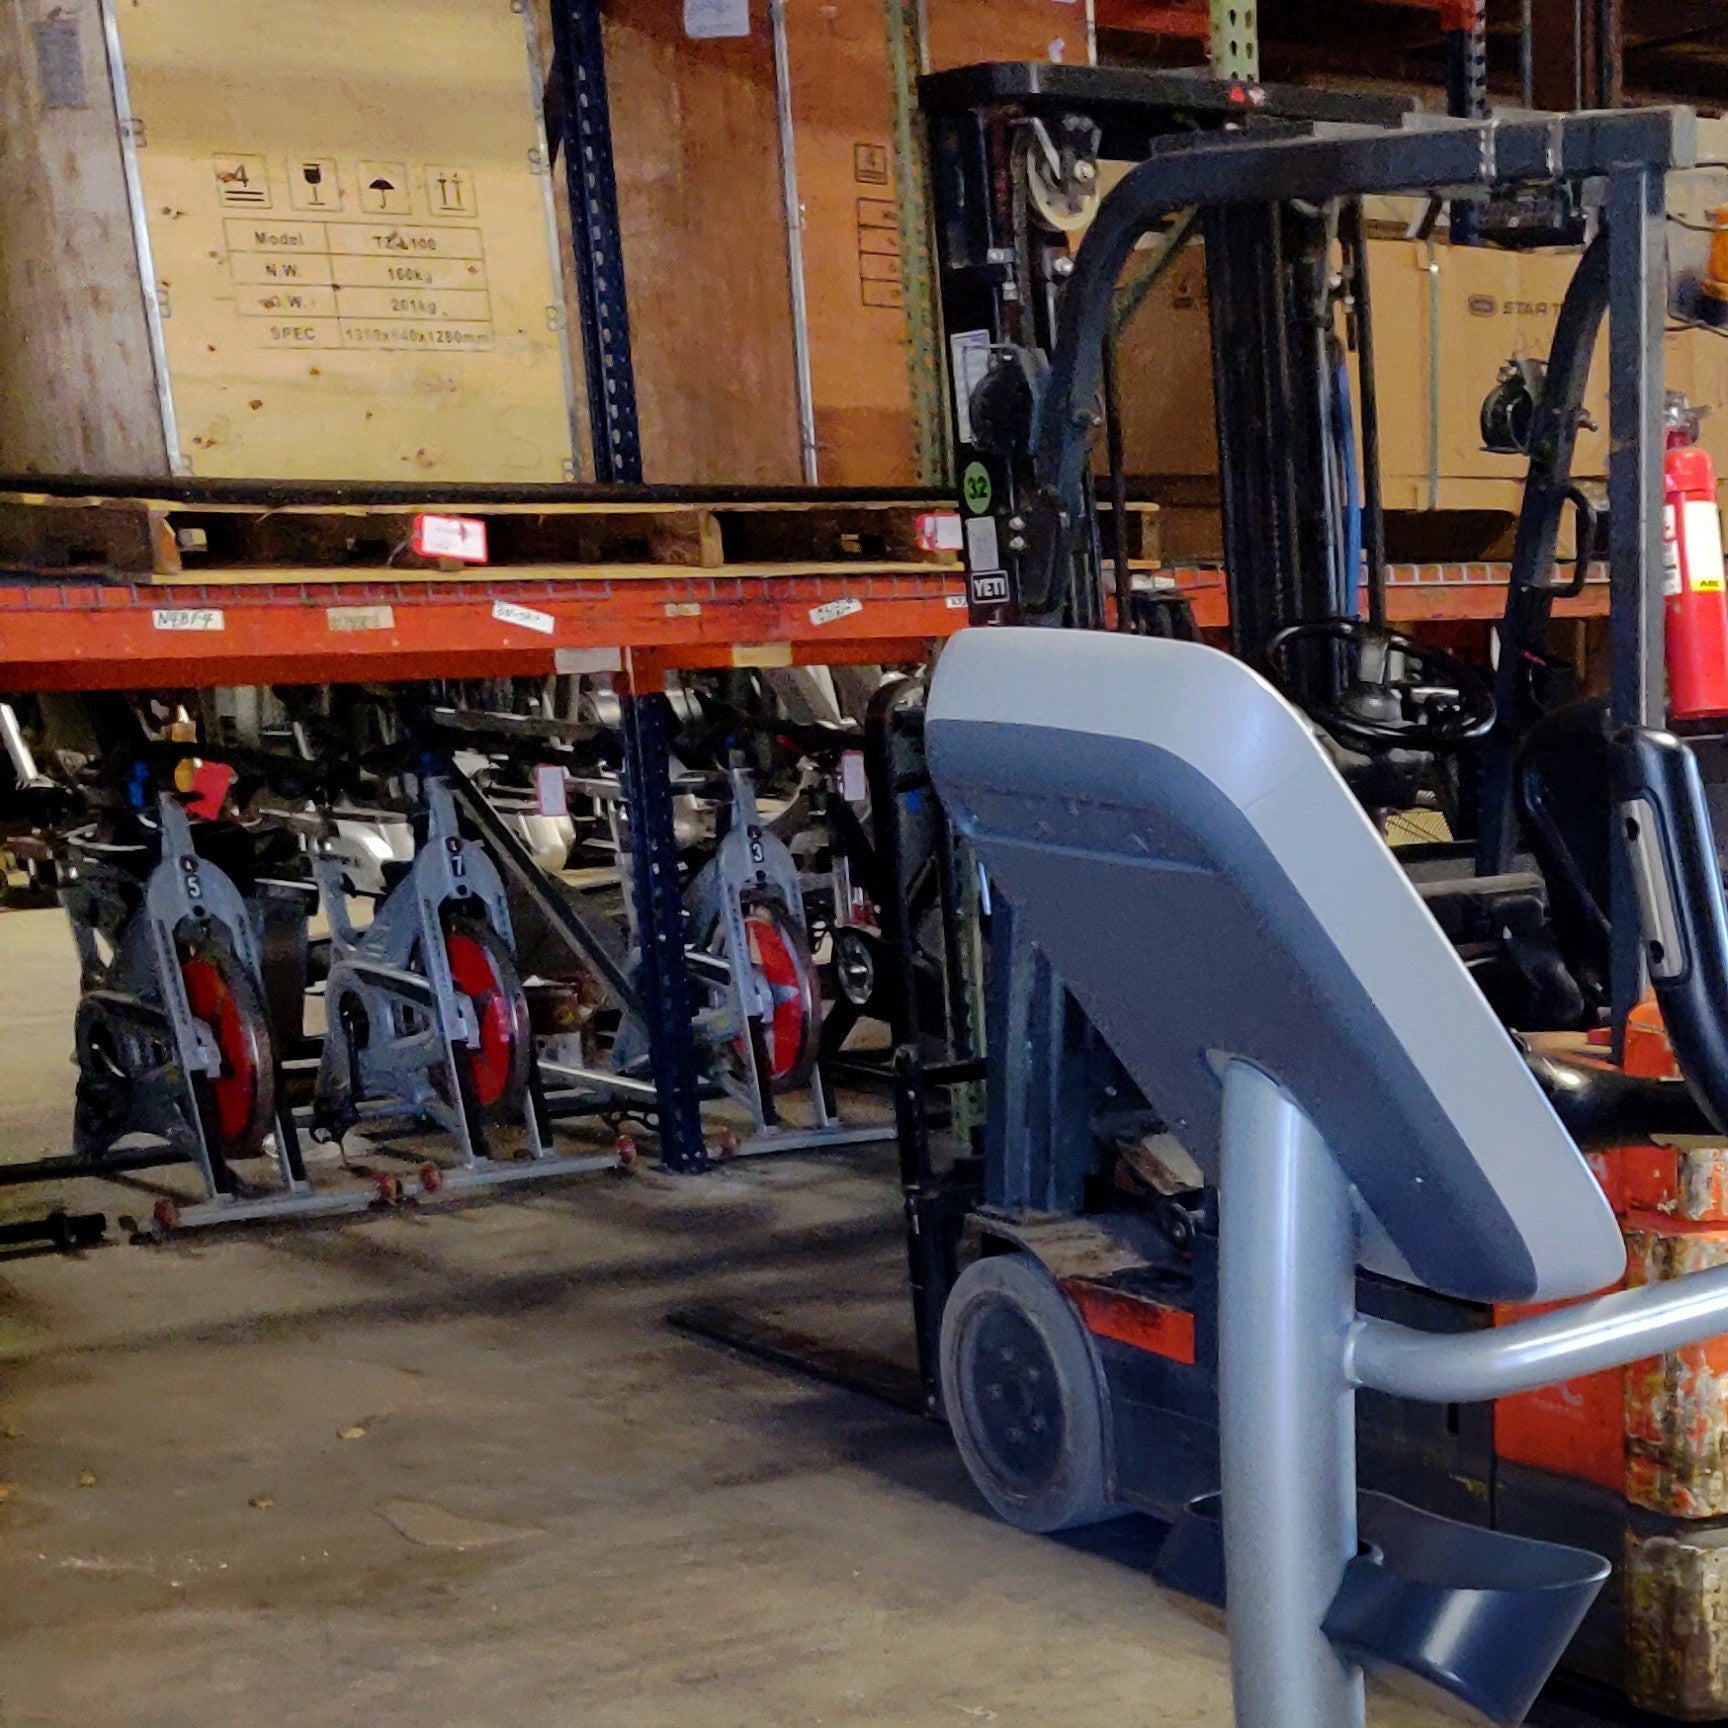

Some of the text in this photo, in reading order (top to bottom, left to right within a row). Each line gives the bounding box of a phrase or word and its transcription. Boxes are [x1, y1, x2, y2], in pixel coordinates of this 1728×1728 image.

[254, 231, 303, 246] Model
[271, 326, 316, 340] SPEC
[967, 475, 987, 499] 32
[974, 578, 1006, 598] YETI
[752, 843, 763, 862] 3
[451, 855, 463, 876] 7
[187, 876, 200, 897] 5
